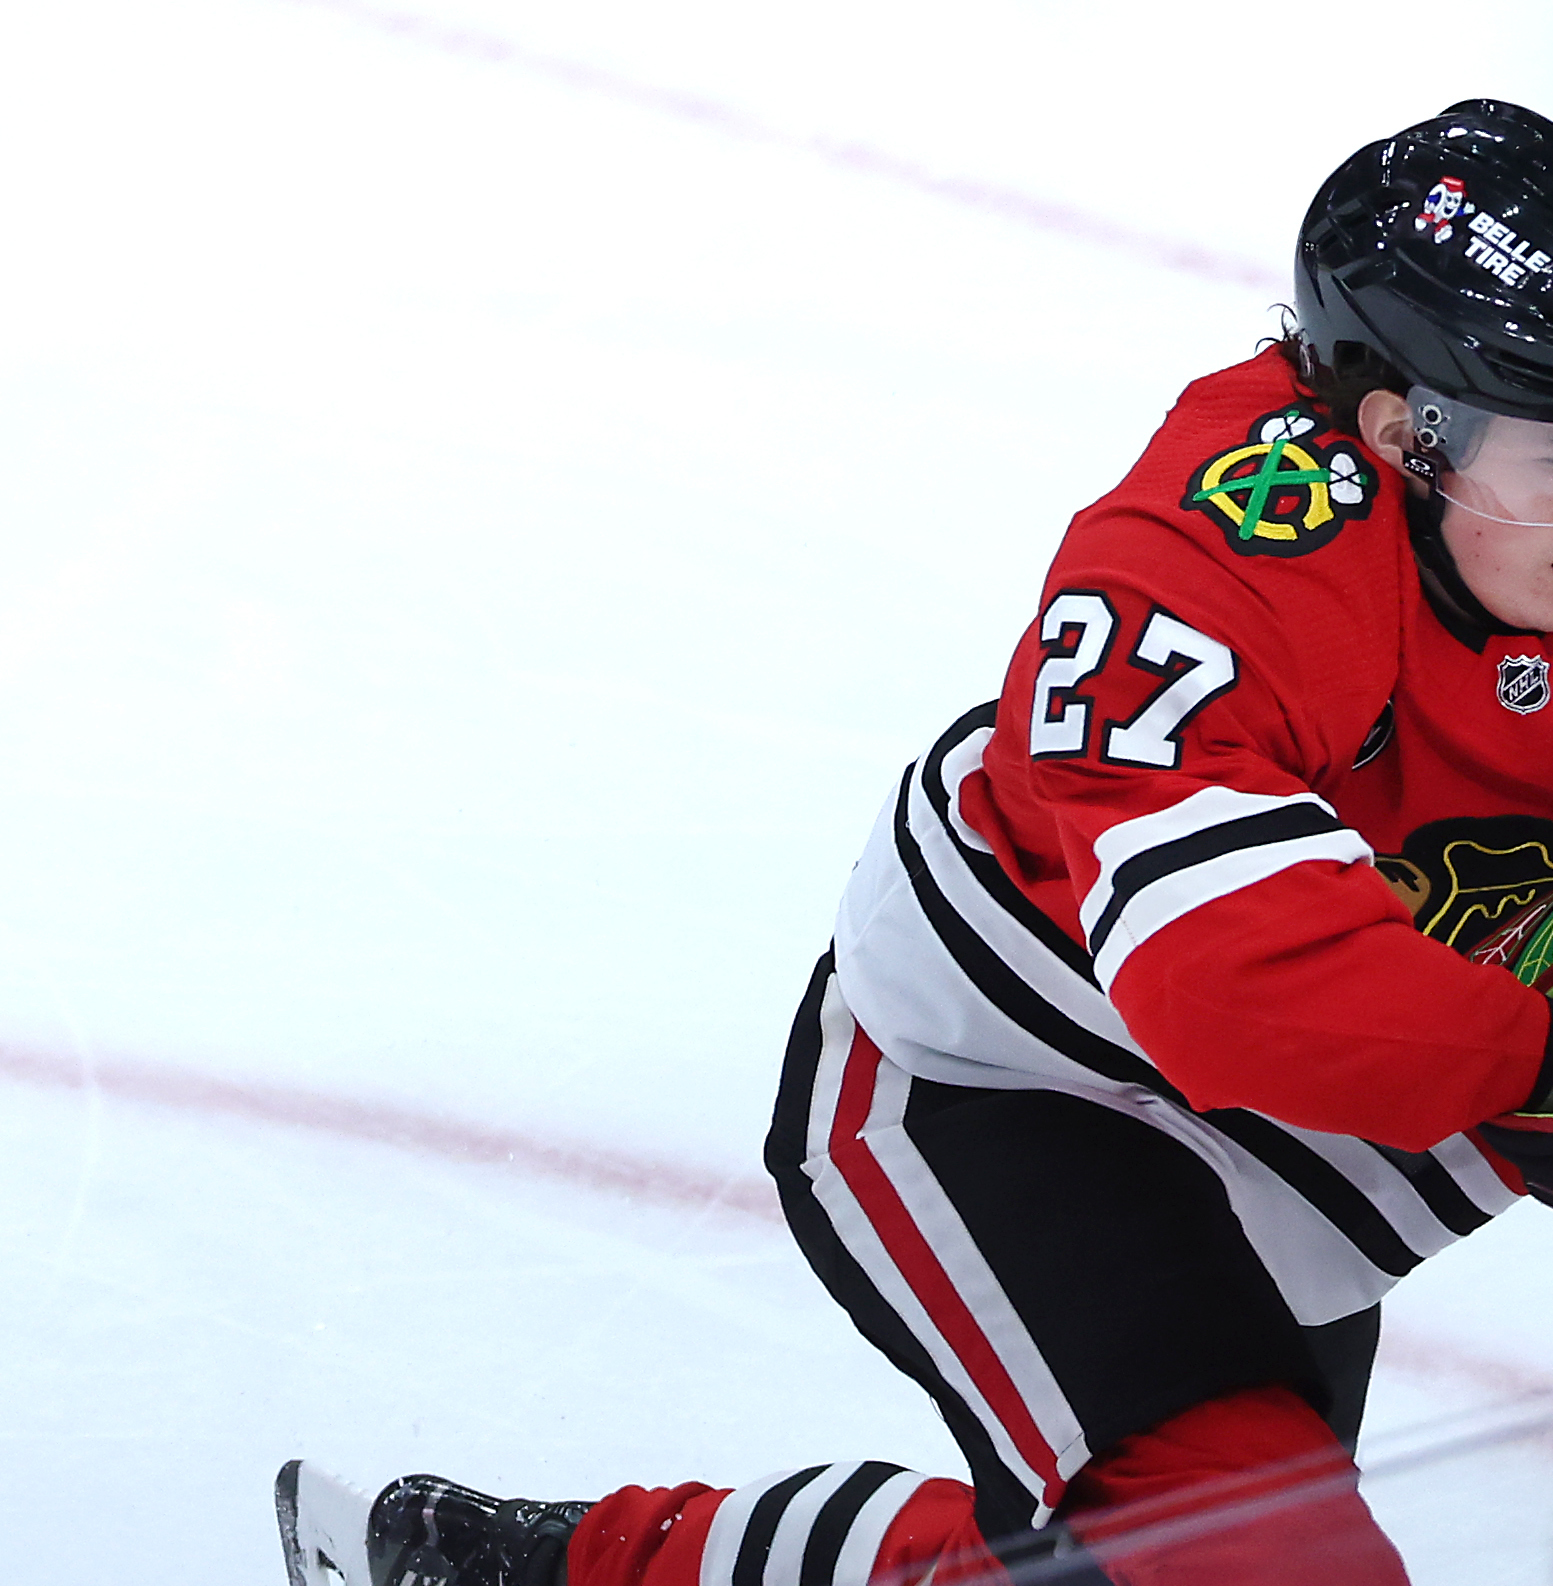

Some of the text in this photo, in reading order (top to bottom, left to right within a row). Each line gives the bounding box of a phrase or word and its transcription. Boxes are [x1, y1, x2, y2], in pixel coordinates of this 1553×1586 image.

[1464, 236, 1526, 286] TIRE
[1467, 211, 1551, 273] BELLE
[1030, 589, 1239, 771] 27
